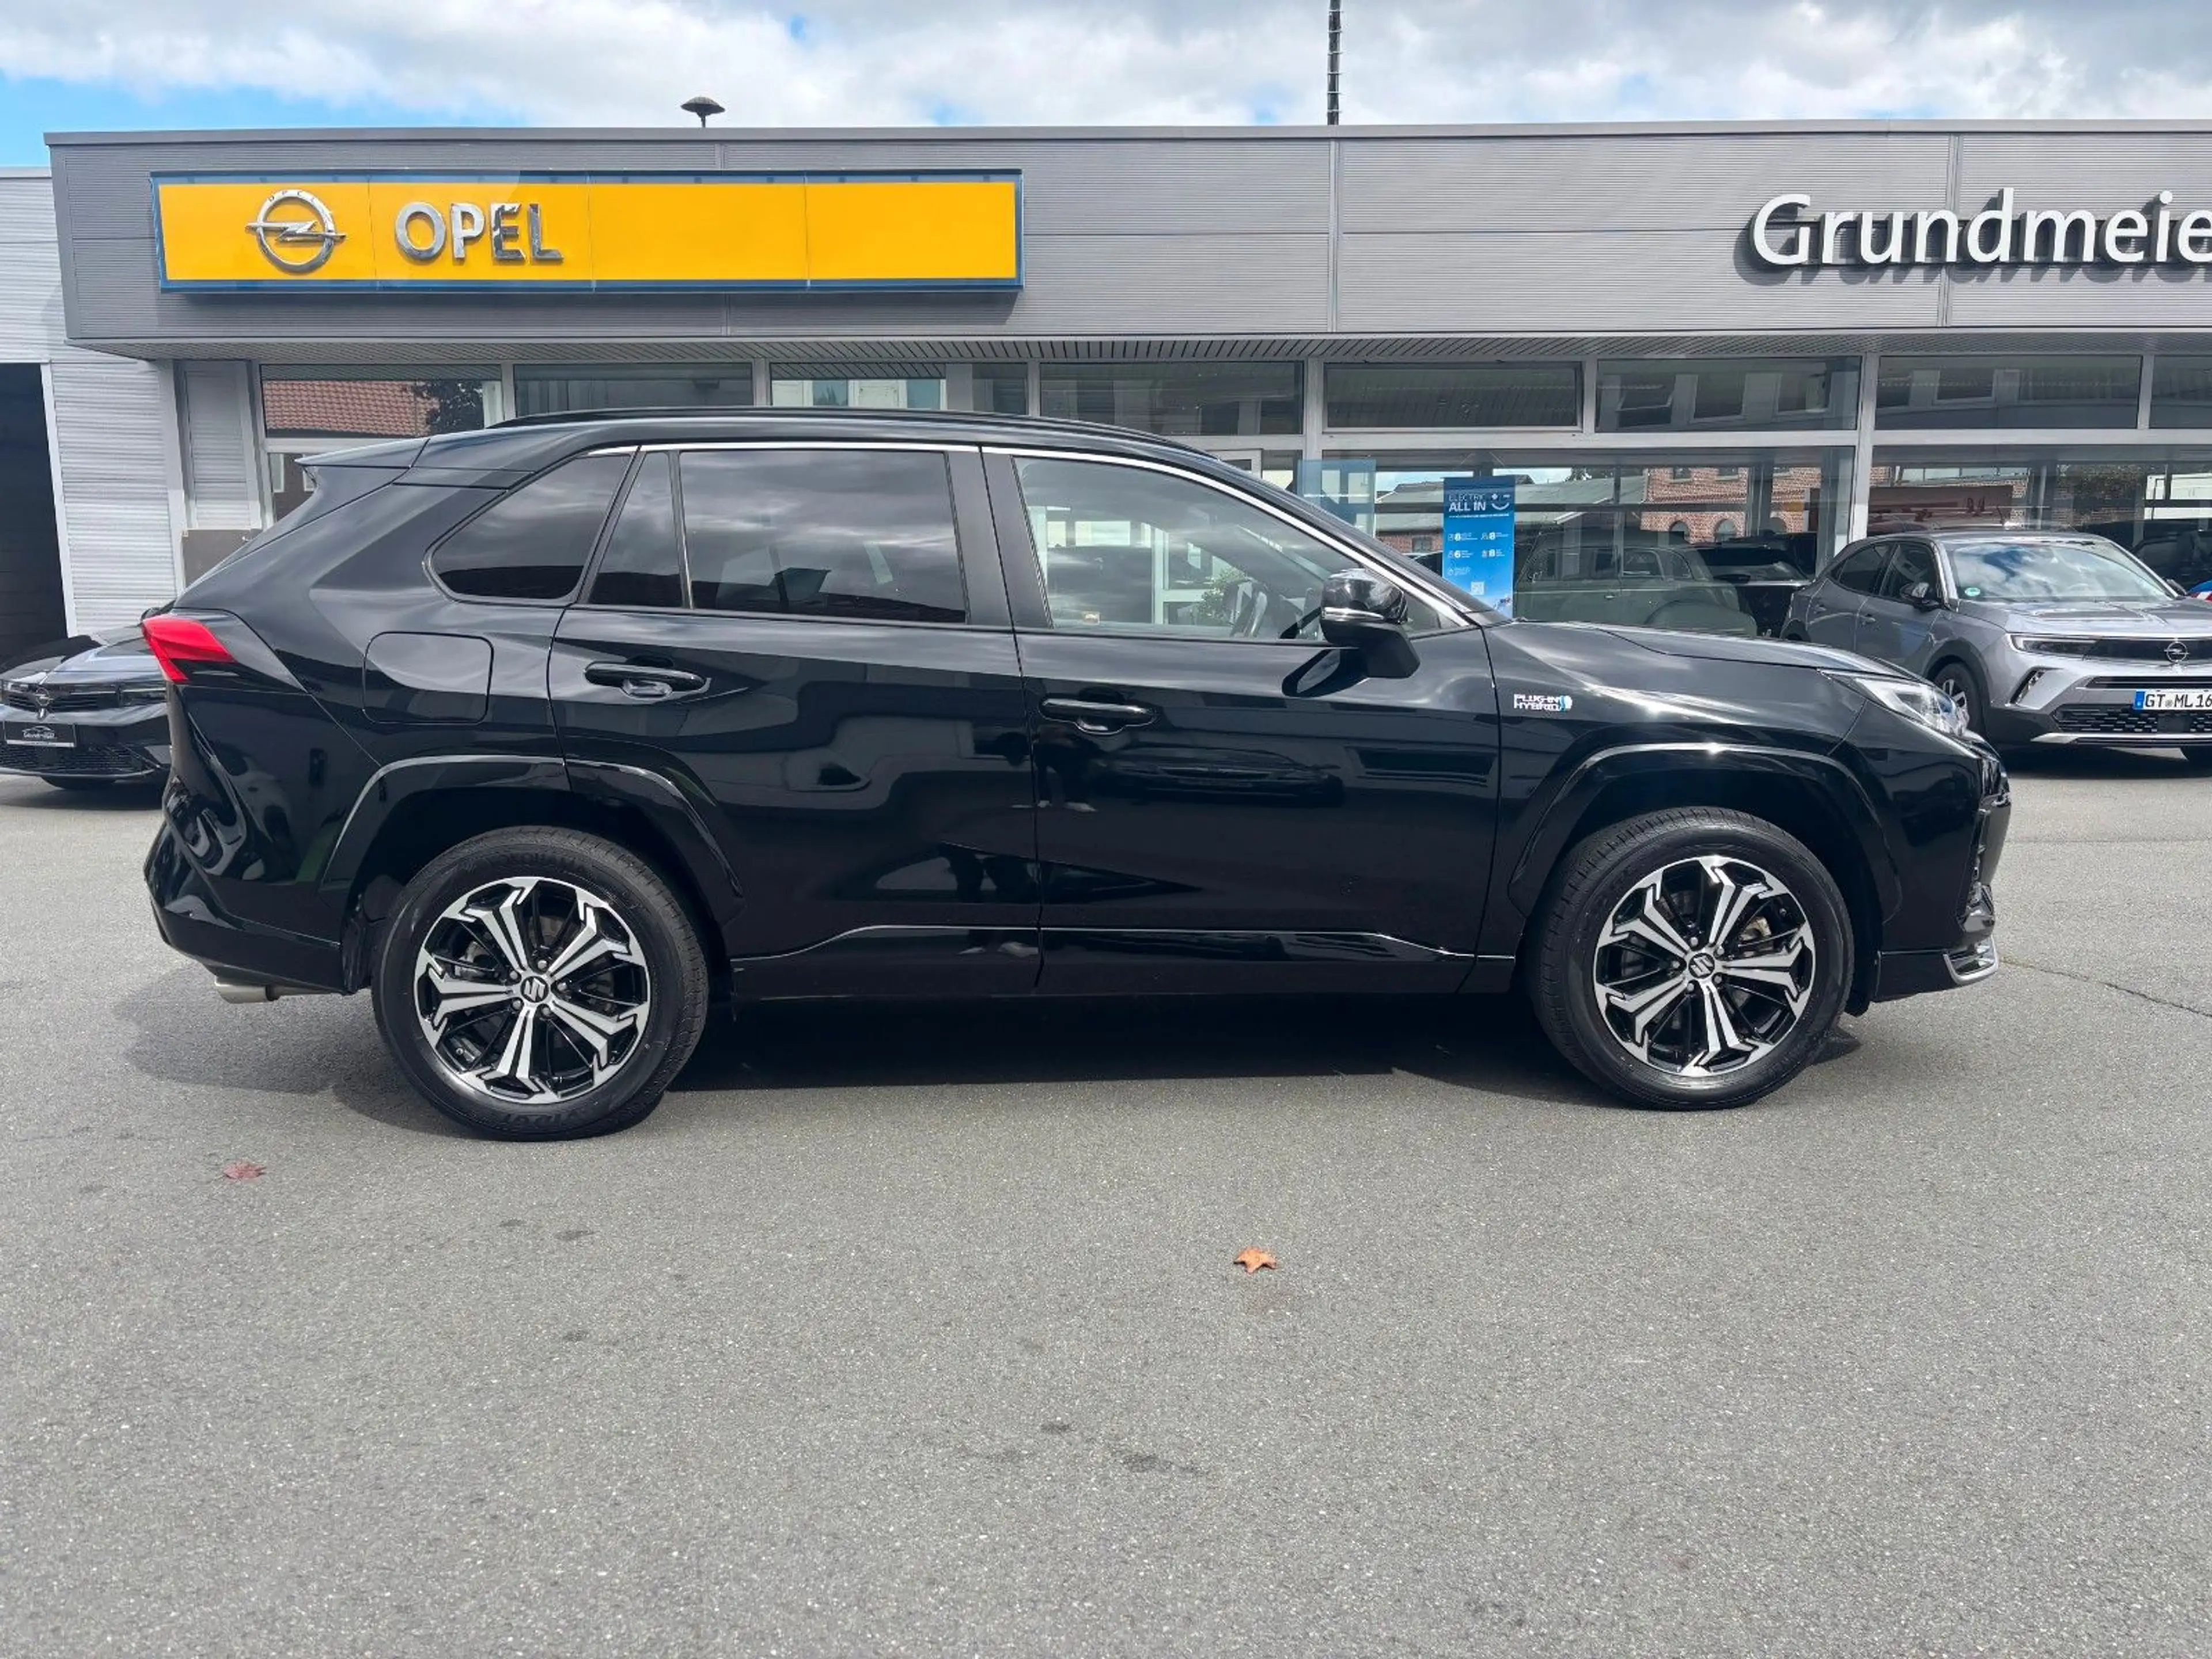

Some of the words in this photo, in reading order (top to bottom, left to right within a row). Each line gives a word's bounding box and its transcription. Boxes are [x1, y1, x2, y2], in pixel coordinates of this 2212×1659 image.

[395, 201, 564, 266] OPEL
[1749, 187, 2212, 266] Grundmeie
[1448, 502, 1471, 512] ALL
[1474, 501, 1486, 512] IN
[2145, 694, 2165, 707] GT
[2174, 694, 2193, 708] ML
